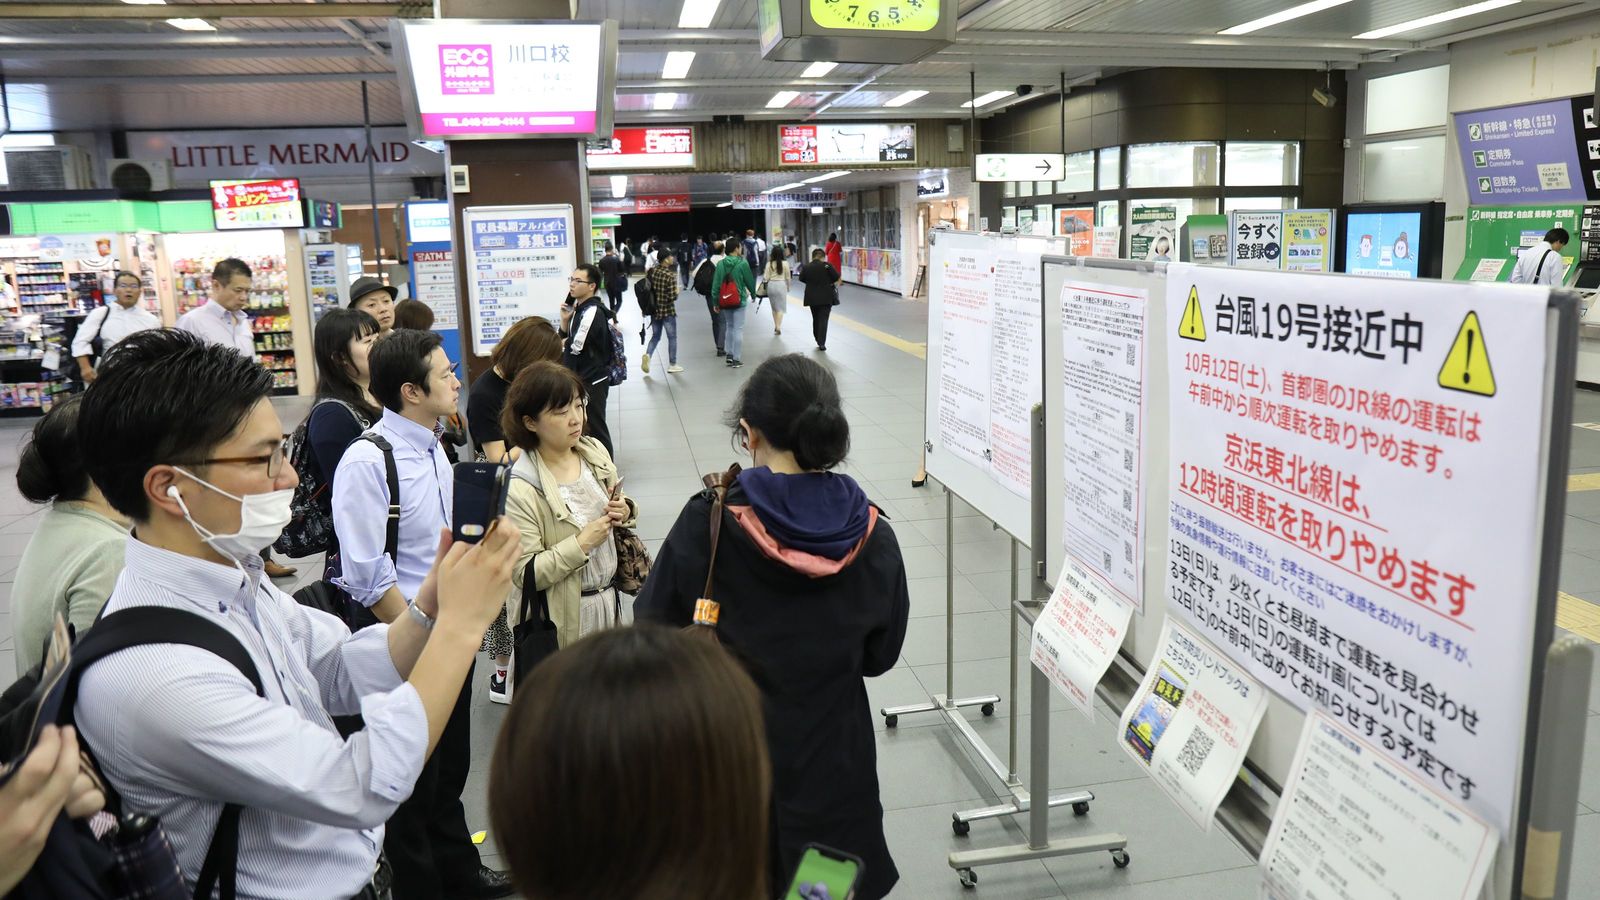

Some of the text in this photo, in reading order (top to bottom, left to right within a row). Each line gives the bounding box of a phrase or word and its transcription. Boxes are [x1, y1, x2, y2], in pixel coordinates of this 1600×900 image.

[848, 5, 859, 17] 7
[868, 11, 879, 23] 6
[888, 7, 899, 20] 5
[443, 48, 489, 65] ECC
[509, 44, 570, 63] 川口校
[1535, 128, 1555, 136] Express
[172, 142, 410, 168] LITTLE MERMAID
[1488, 149, 1512, 160] 定期券
[1493, 176, 1516, 187] 回数券
[476, 221, 565, 234] 駅員長期アルバイト
[1237, 223, 1279, 240] 今すぐ
[516, 233, 565, 248] 募集中!
[1236, 242, 1264, 260] 登録
[1214, 293, 1424, 365] 台風19号接近中
[1184, 351, 1482, 442] 10月12日(土)、首都圏のJR線の運転は
[1188, 379, 1454, 479] 午前中から順次運転を取りやめます。
[1224, 432, 1371, 519] 京浜東北線は、
[1179, 462, 1476, 617] 12時頃運転を取りやめます
[1170, 538, 1480, 736] 13日(日)は、少なくとも昼頃まで運転を見合わせ
[1170, 564, 1438, 744] る予定です。13日(日)の運転計画については
[1171, 585, 1478, 801] 12日(土)の午前中に改めてお知らせする予定です
